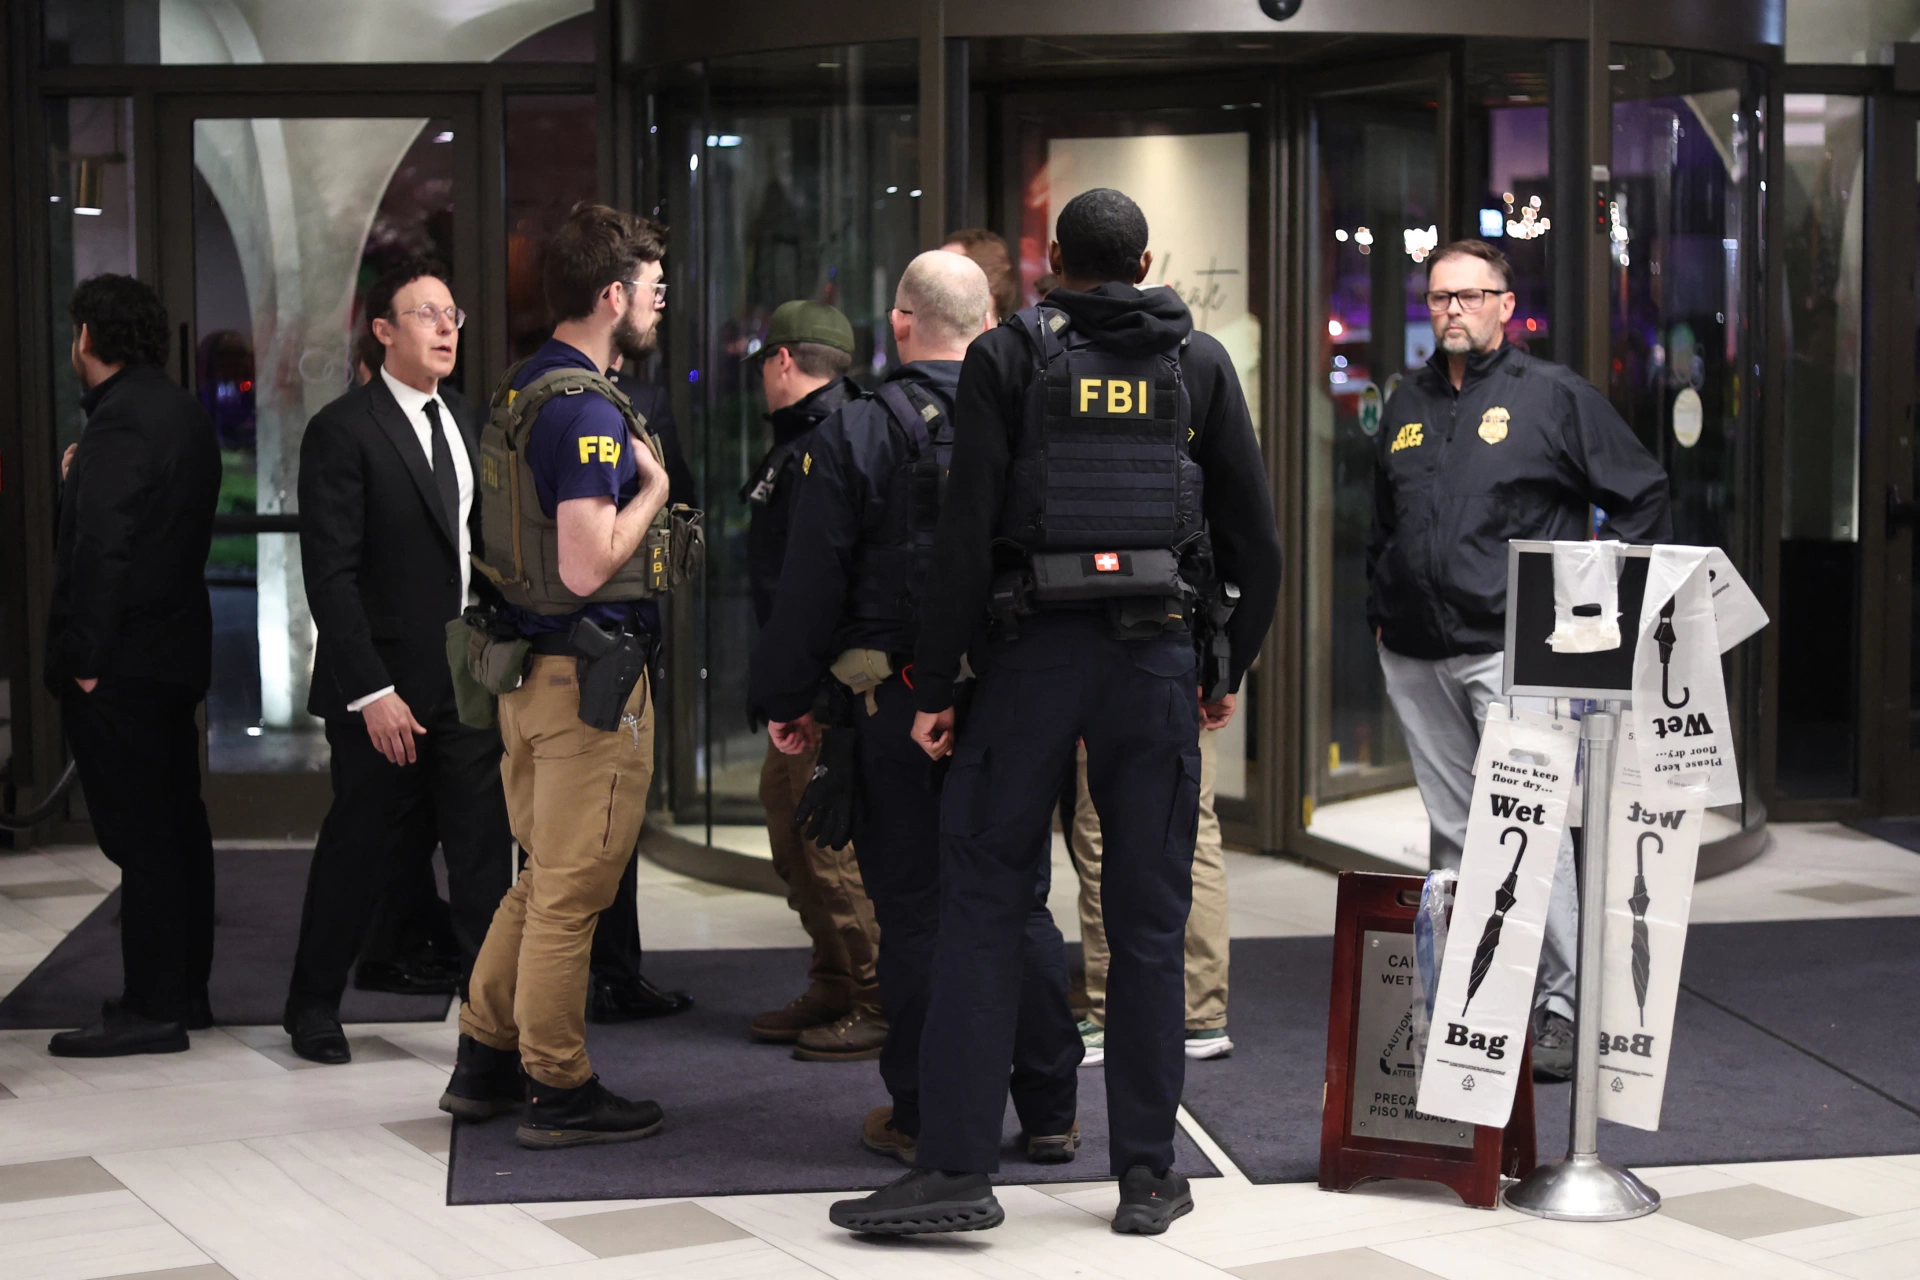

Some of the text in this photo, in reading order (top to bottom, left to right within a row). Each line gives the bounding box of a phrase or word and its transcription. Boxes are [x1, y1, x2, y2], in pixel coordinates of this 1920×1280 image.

[1079, 378, 1147, 414] FBI
[653, 548, 663, 586] FBI
[1652, 713, 1714, 739] Wet
[1656, 746, 1717, 758] floor dry...
[1491, 760, 1559, 782] Please keep
[1654, 757, 1723, 772] Please keep
[1492, 773, 1553, 793] floor dry...
[1490, 793, 1546, 825] Wet
[1381, 973, 1414, 986] WET
[1383, 1011, 1413, 1058] CAUTION
[1444, 1022, 1509, 1060] Bag
[1375, 1092, 1417, 1107] PRECA
[1370, 1105, 1399, 1118] PISO
